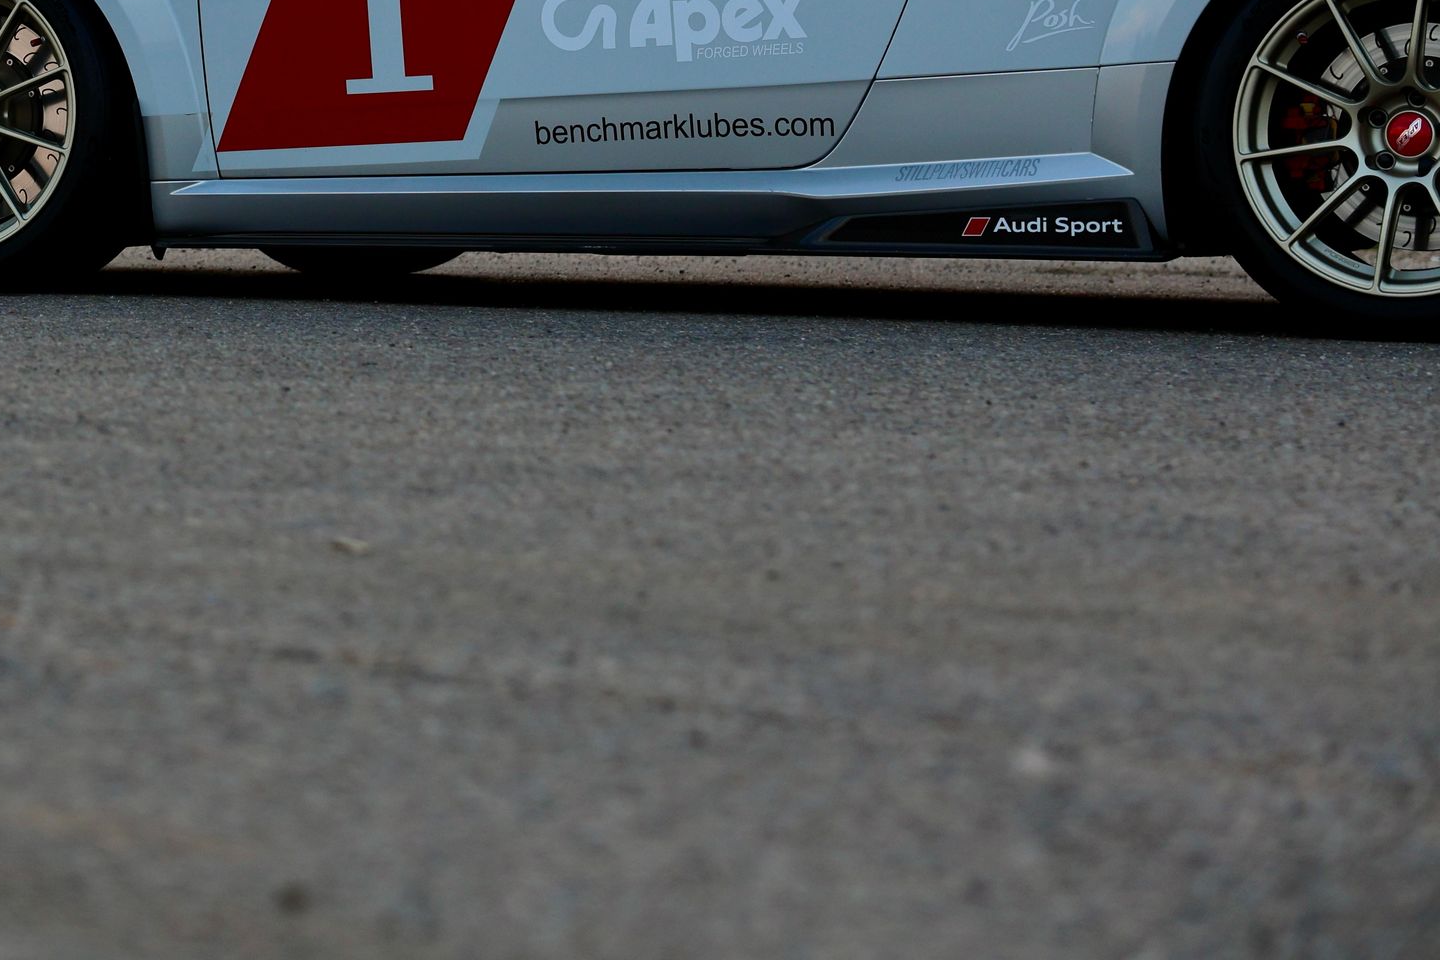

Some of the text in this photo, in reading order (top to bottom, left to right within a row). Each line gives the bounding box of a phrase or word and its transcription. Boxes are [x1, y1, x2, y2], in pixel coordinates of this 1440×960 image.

[696, 42, 804, 60] FORGED WHEELS
[534, 113, 836, 145] benchmarklubes.com
[895, 158, 1041, 182] STILLPLAYSWITHCARS
[993, 216, 1123, 237] Audi Sport
